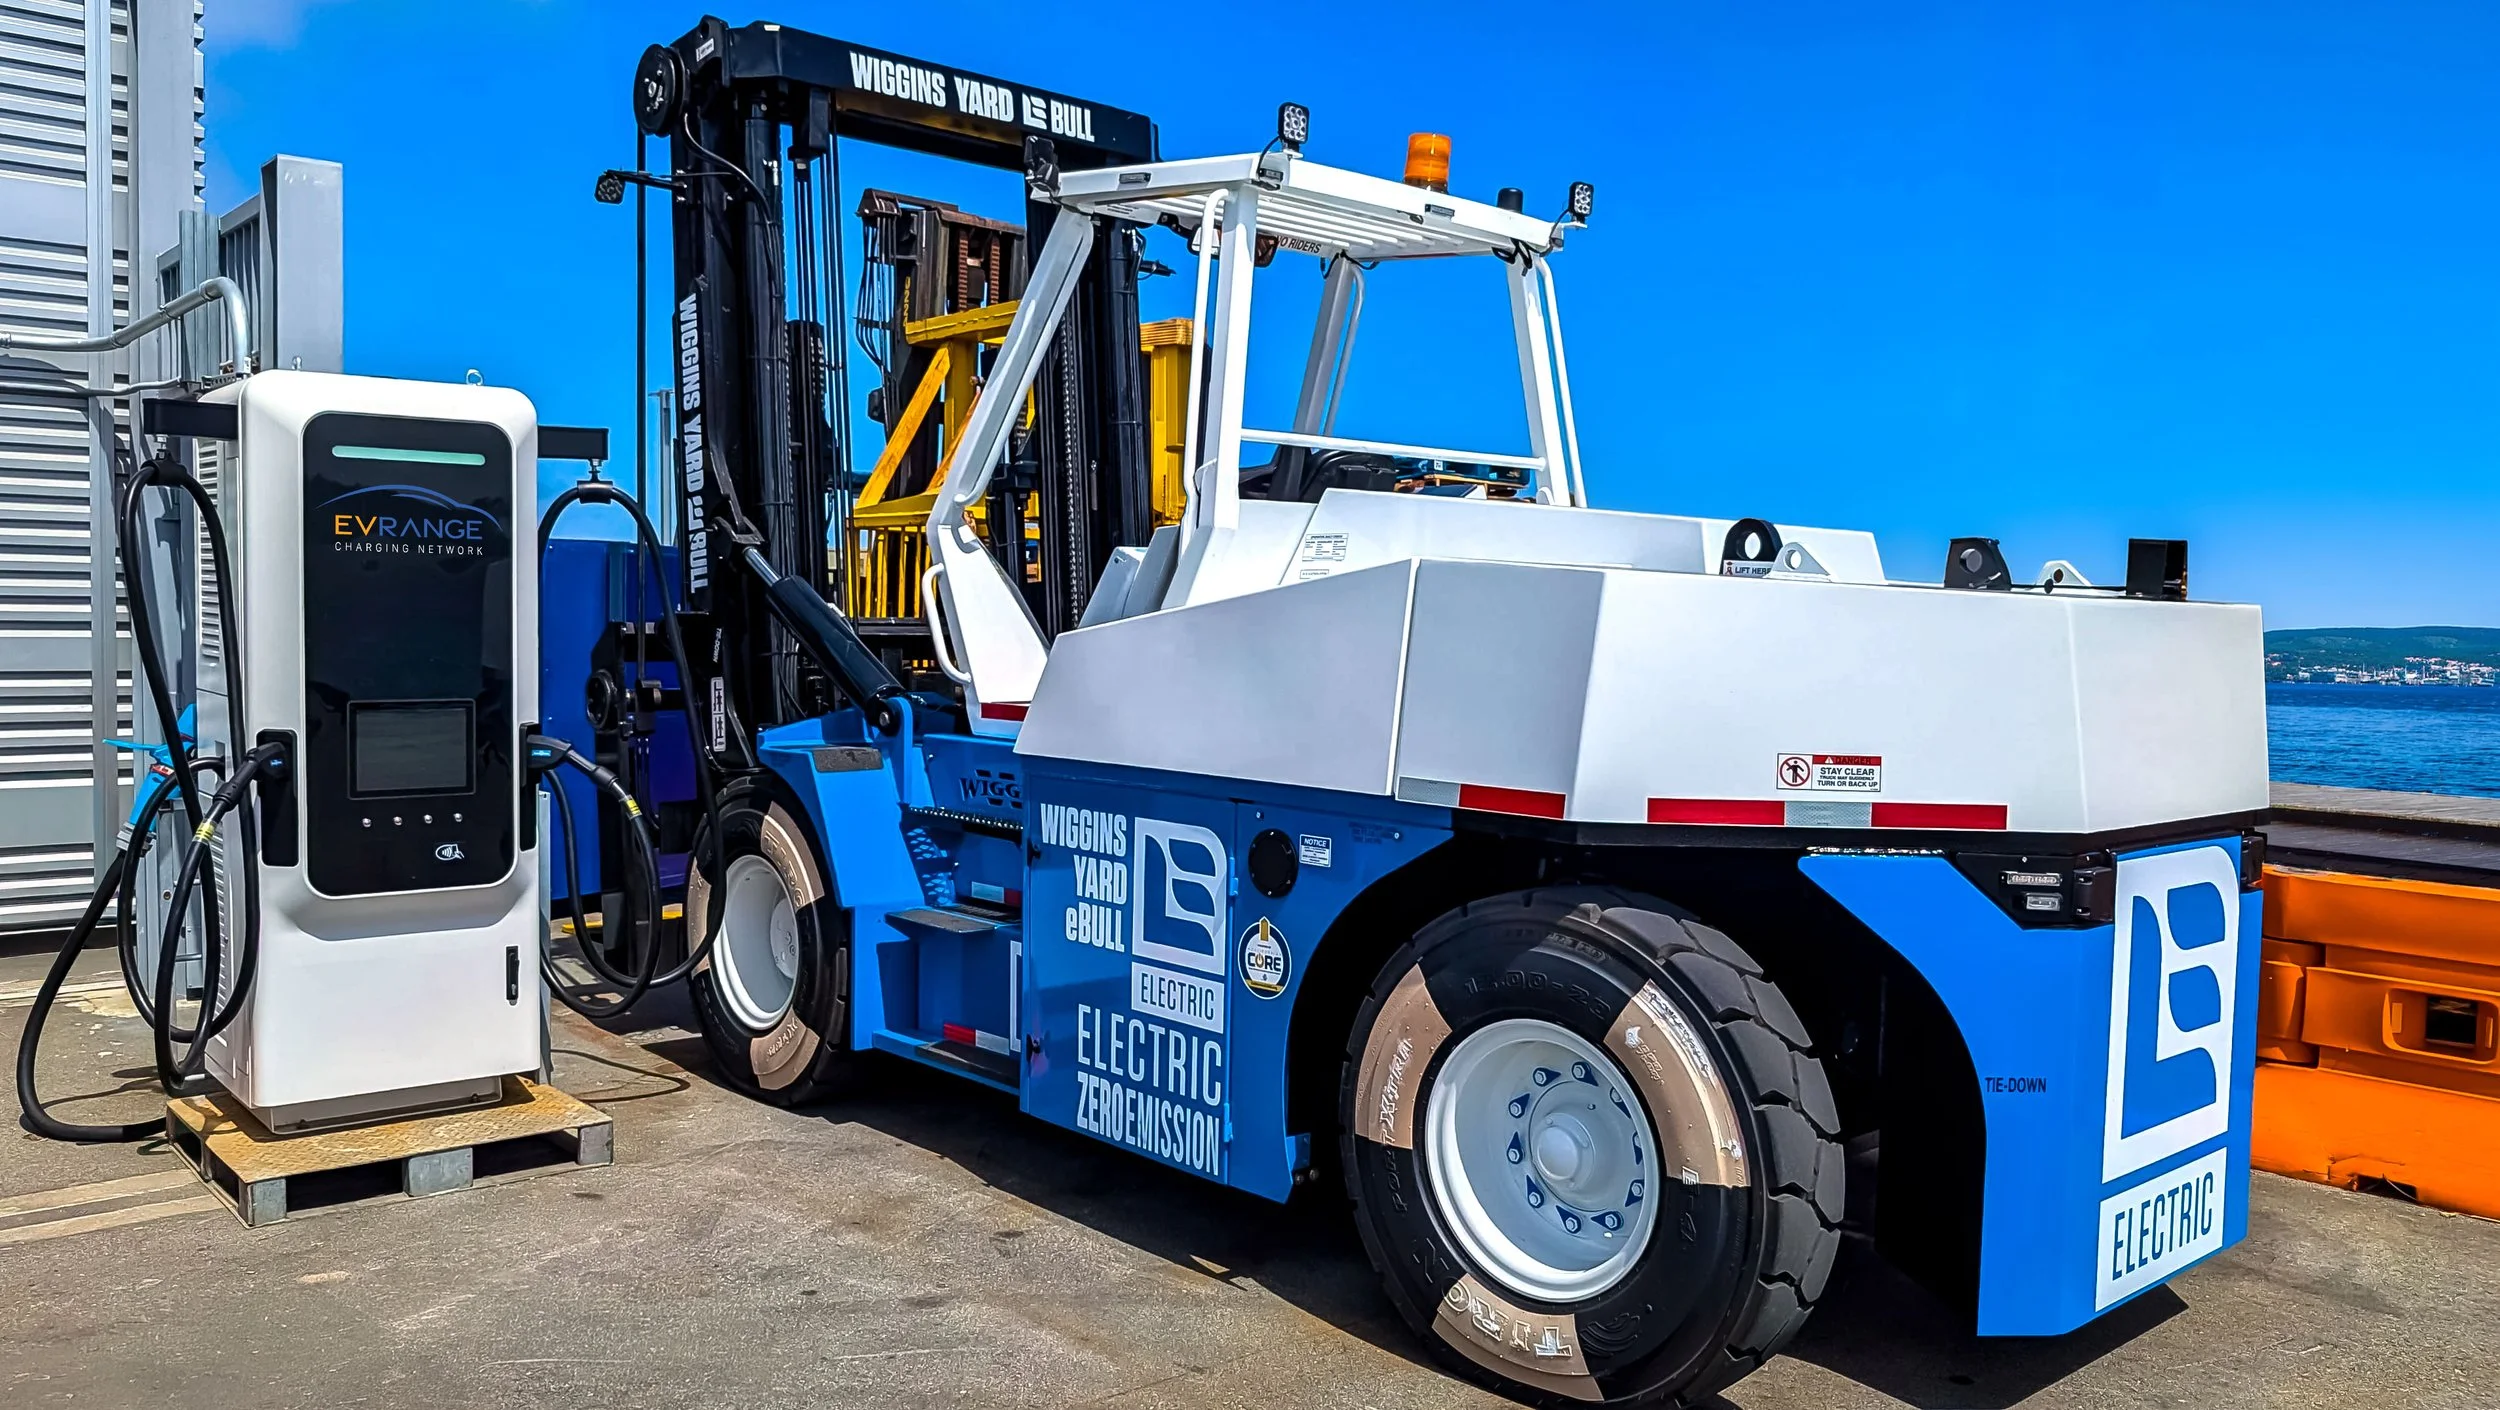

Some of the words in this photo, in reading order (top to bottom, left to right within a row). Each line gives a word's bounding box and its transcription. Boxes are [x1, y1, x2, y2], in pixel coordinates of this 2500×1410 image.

[849, 51, 946, 108] WIGGINS
[953, 75, 1014, 122] YARD
[1050, 99, 1095, 142] BULL
[1288, 238, 1321, 254] RIDERS
[679, 292, 701, 412] WIGGINS
[683, 413, 705, 493] YARD
[334, 514, 483, 540] EVRANGE
[334, 541, 410, 553] CHARGING
[418, 544, 484, 556] NETWORK
[688, 530, 709, 594] BULL
[1734, 566, 1751, 574] LIFT
[1820, 766, 1843, 775] STAY
[1844, 767, 1875, 776] CLEAR
[1848, 780, 1867, 788] BACK
[1040, 803, 1127, 858] WIGGINS
[1303, 837, 1327, 848] NOTICE
[1073, 855, 1128, 906] YARD
[1065, 905, 1125, 953] eBULL
[1247, 952, 1282, 972] CORE
[1140, 972, 1216, 1021] ELECTRIC
[1077, 1003, 1222, 1107] ELECTRIC
[1984, 1077, 2047, 1093] TIE-DOWN
[1076, 1070, 1220, 1177] ZEROEMISSION
[2112, 1171, 2214, 1282] ELECTRIC
